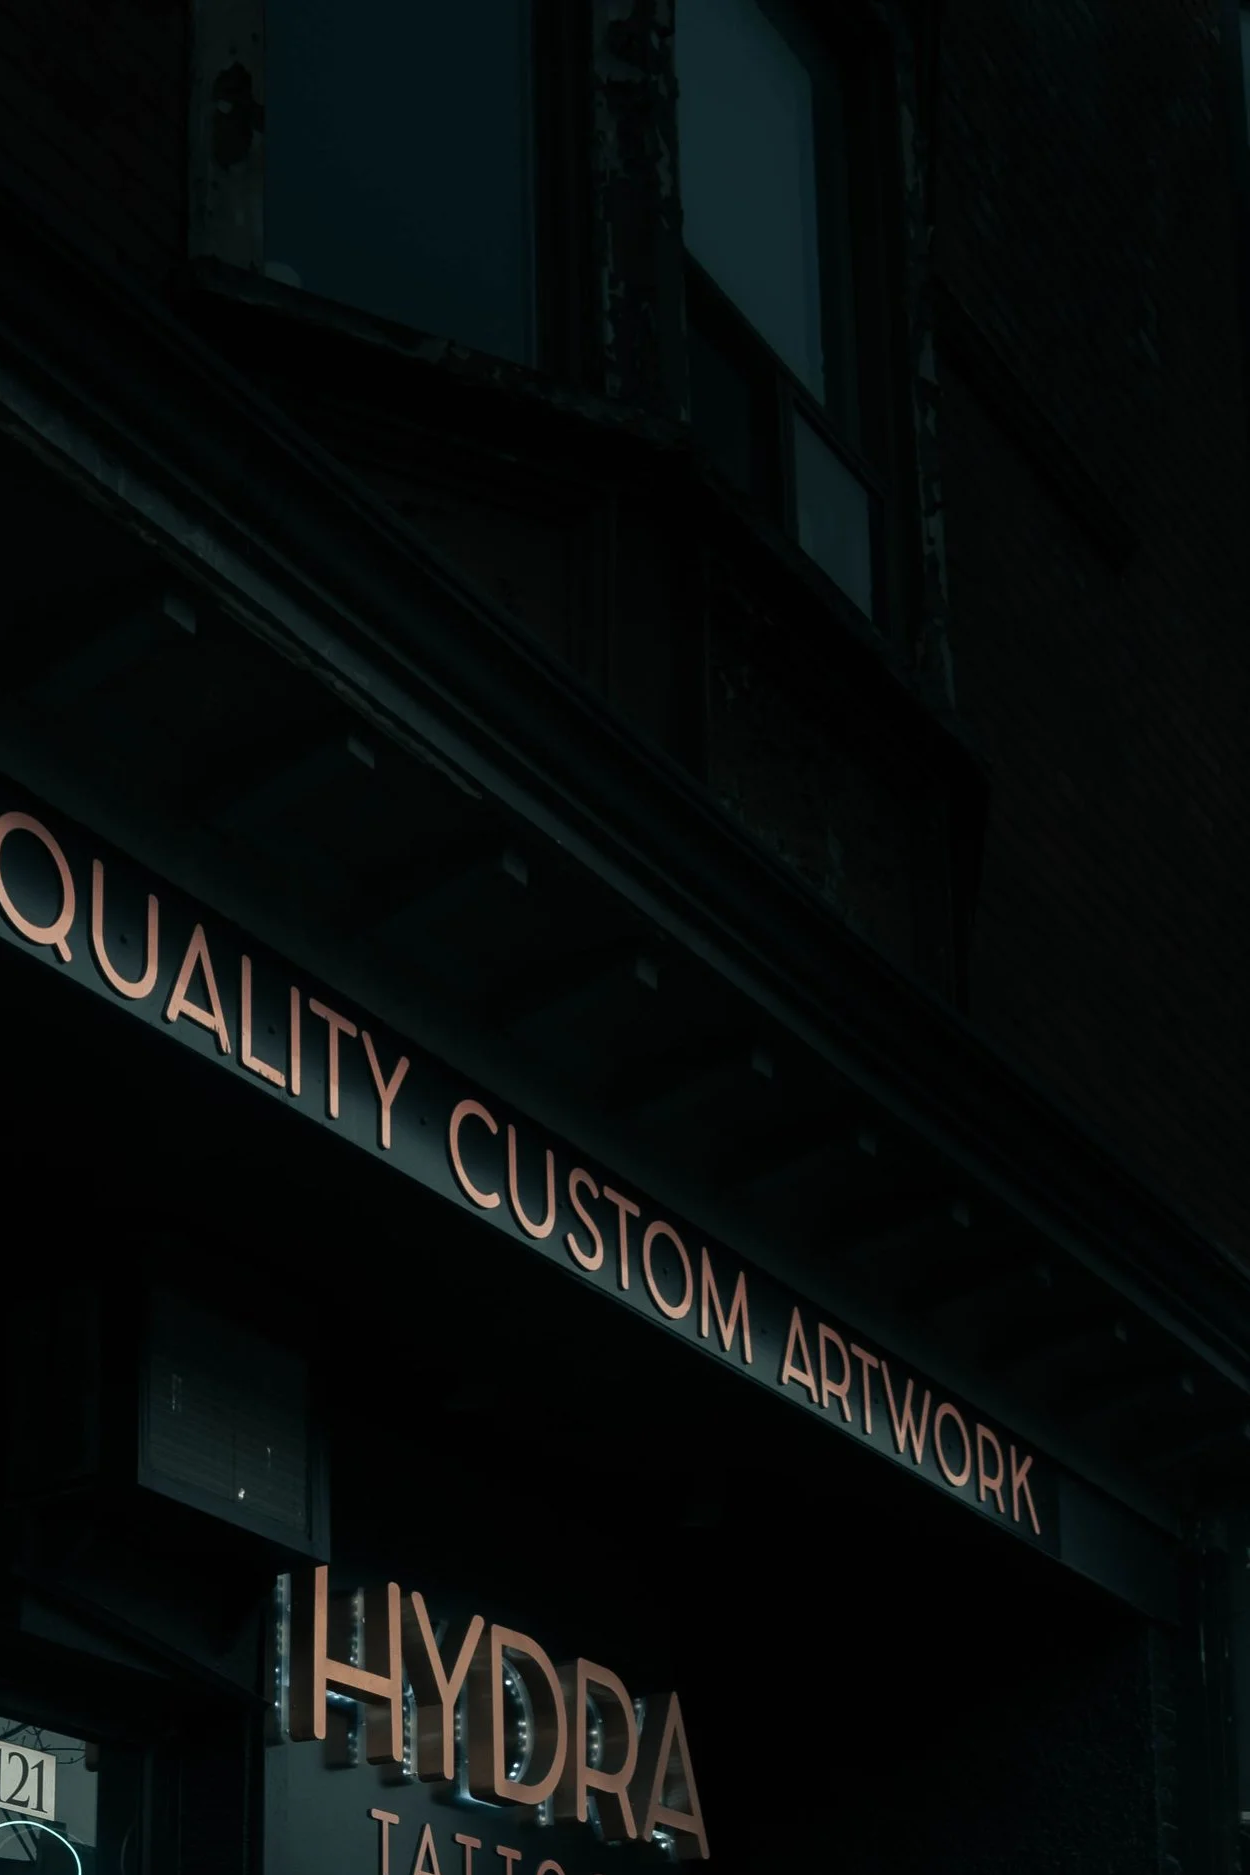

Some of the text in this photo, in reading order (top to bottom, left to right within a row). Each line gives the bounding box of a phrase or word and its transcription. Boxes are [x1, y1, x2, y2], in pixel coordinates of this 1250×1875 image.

[448, 1098, 753, 1366] CUSTOM
[780, 1304, 1041, 1536] ARTWORK
[312, 1563, 711, 1860] HYDRA
